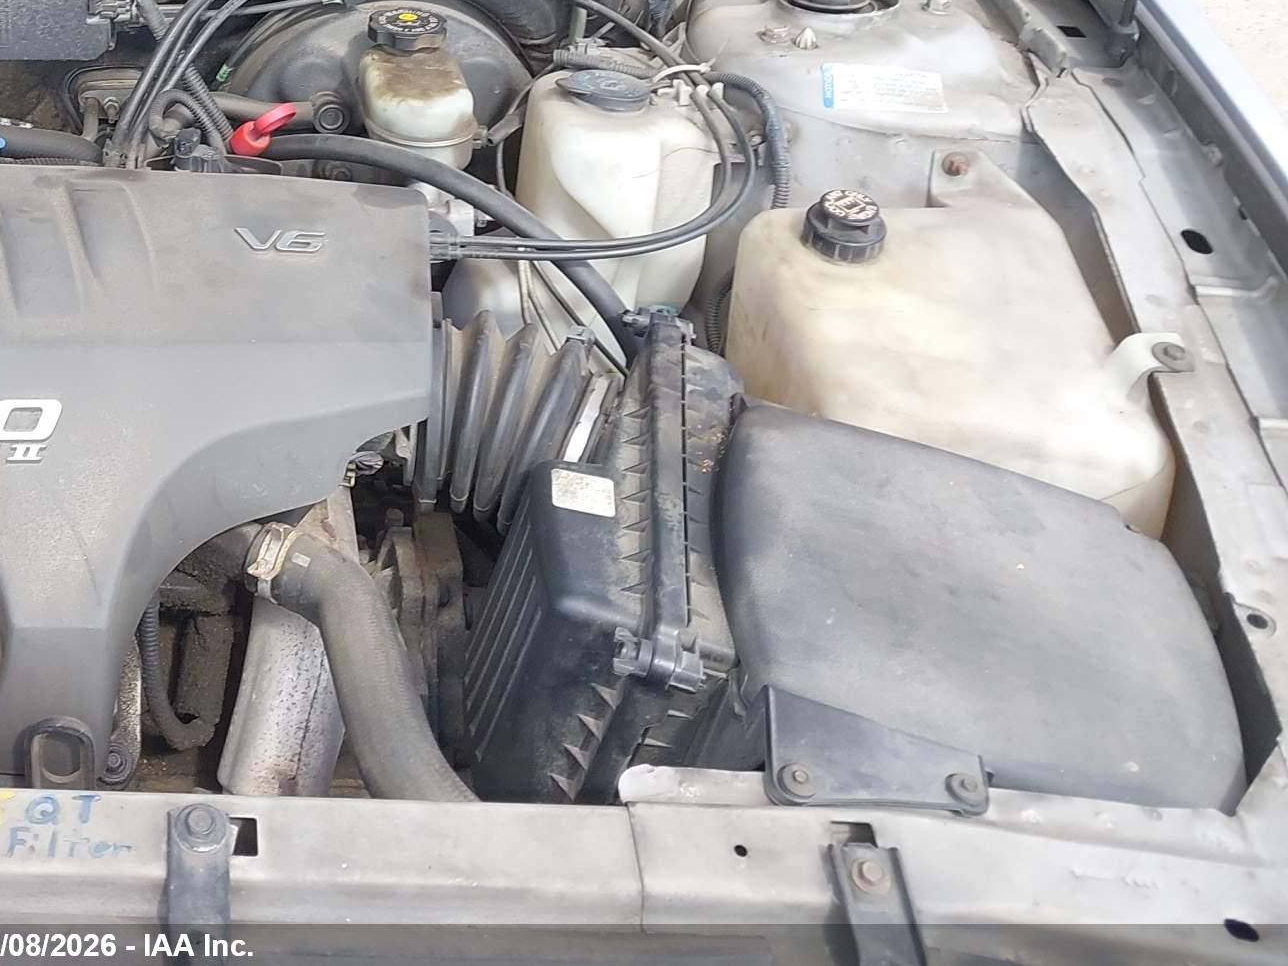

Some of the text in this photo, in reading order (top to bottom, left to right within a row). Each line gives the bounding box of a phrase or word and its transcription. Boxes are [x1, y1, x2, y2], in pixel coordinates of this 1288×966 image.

[233, 227, 326, 253] V6
[5, 443, 48, 464] II
[25, 793, 102, 826] QT
